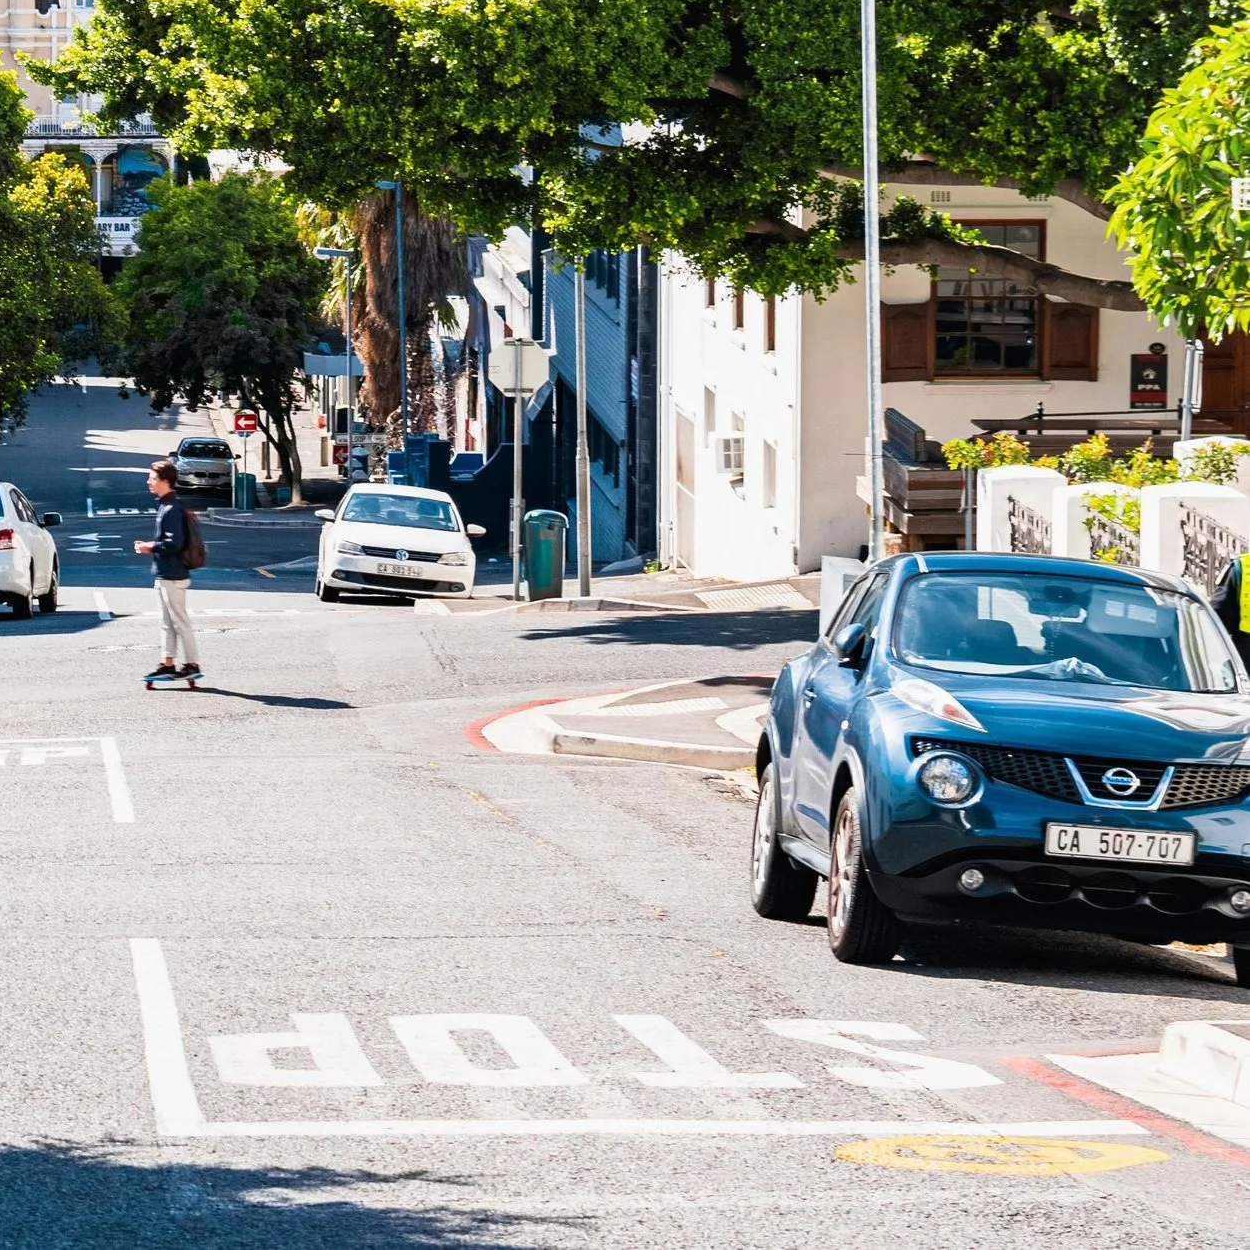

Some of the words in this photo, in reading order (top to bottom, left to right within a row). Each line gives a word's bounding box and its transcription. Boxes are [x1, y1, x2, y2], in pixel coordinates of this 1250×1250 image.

[114, 223, 130, 231] BAR
[1058, 829, 1080, 853] CA
[1099, 832, 1182, 859] 507-707
[207, 1013, 1004, 1090] STOP
